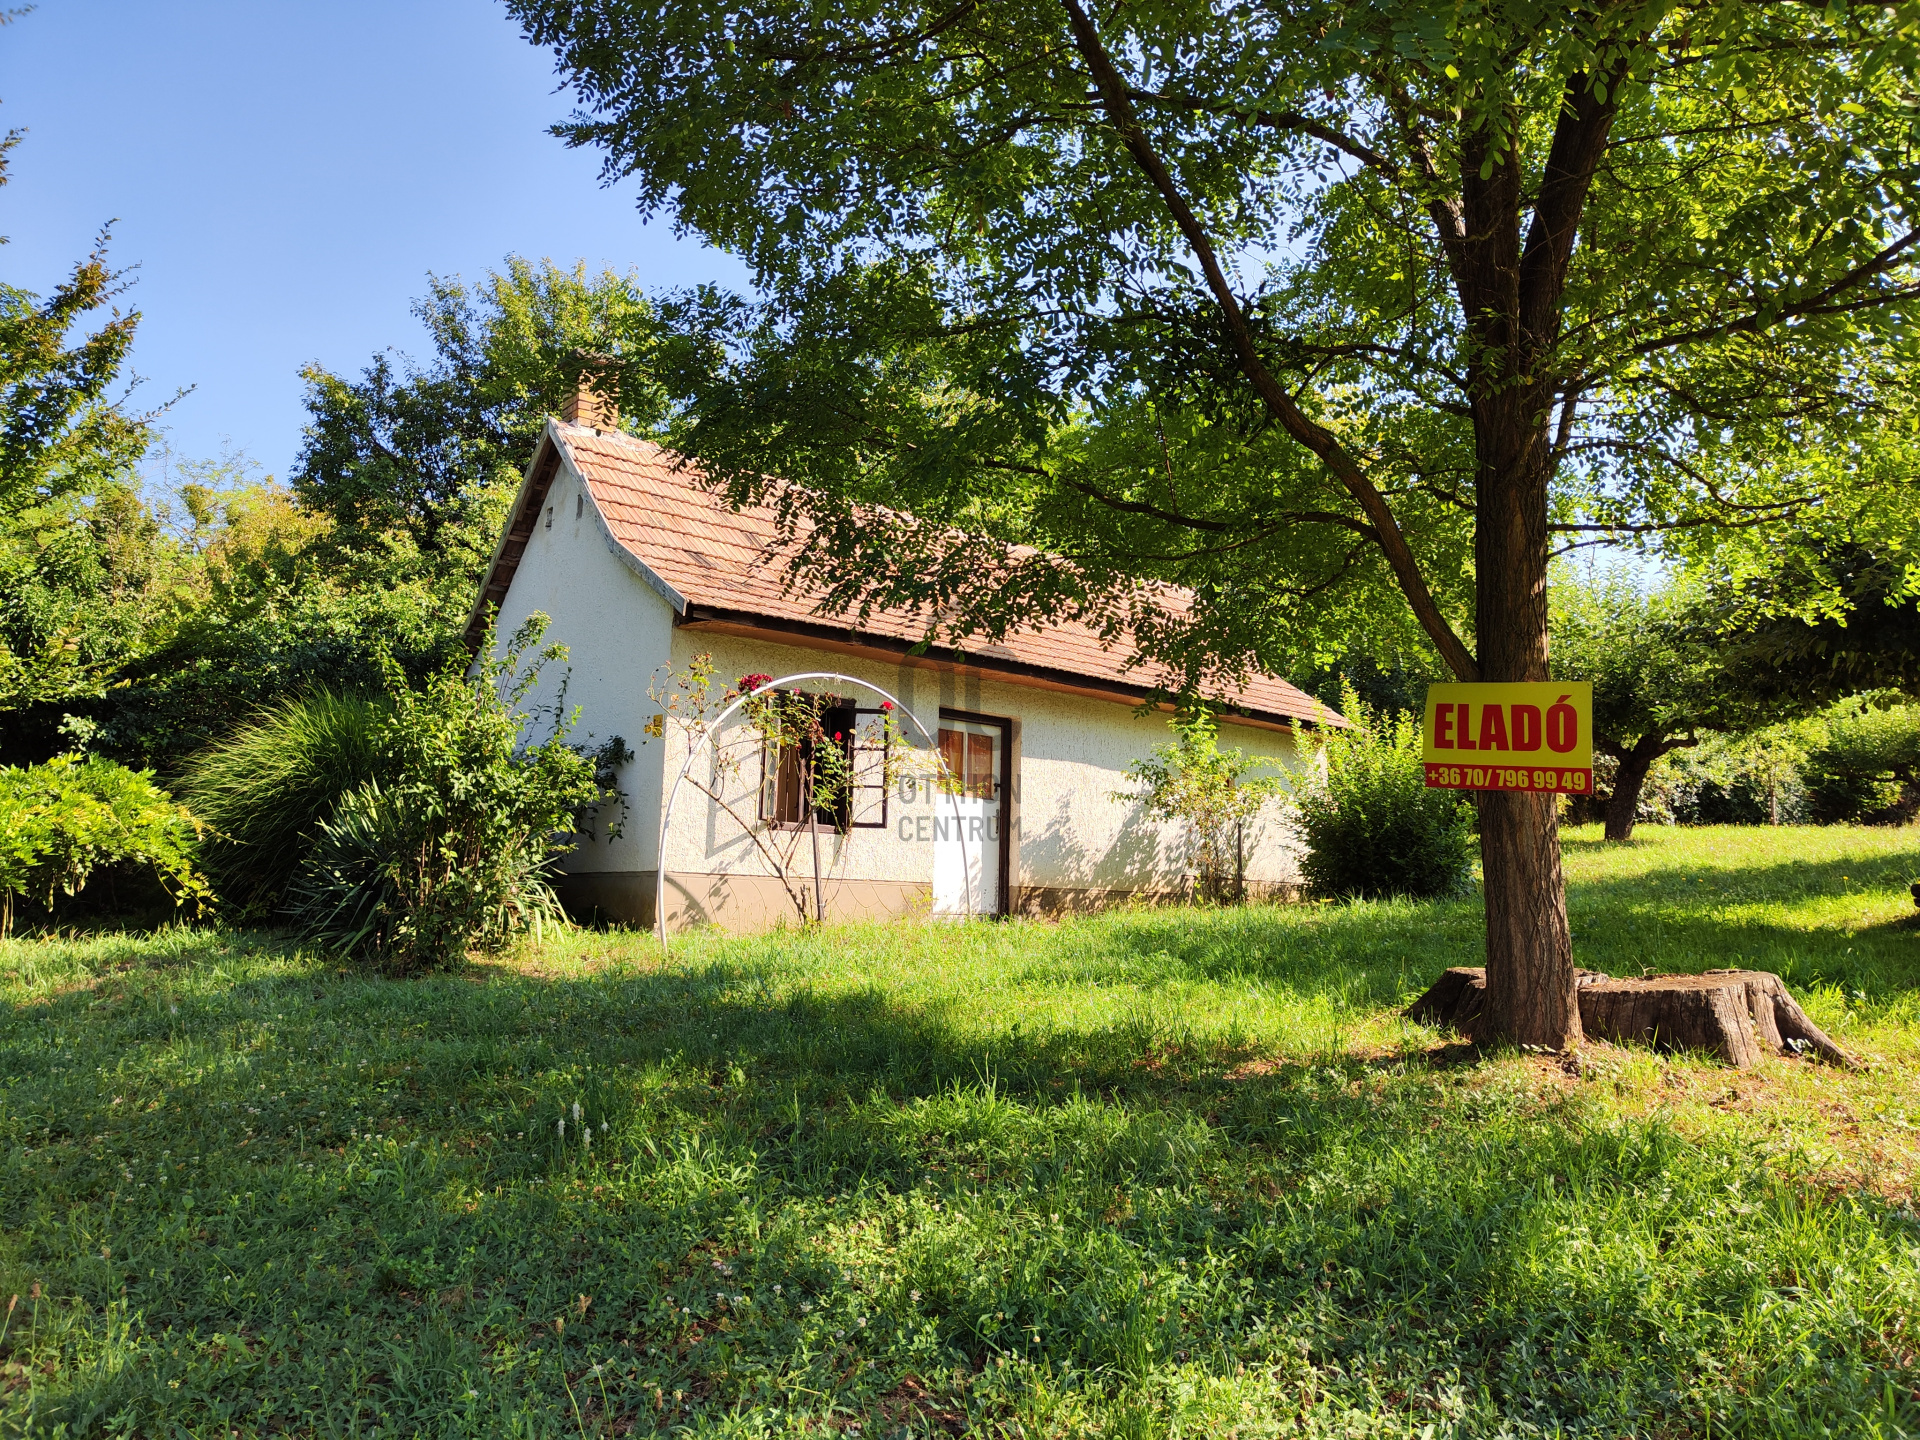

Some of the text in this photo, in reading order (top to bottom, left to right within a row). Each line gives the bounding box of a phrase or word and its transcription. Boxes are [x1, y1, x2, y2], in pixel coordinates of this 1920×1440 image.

[1434, 695, 1577, 753] ELADÓ
[1428, 767, 1586, 791] +36 70/ 796 99 49
